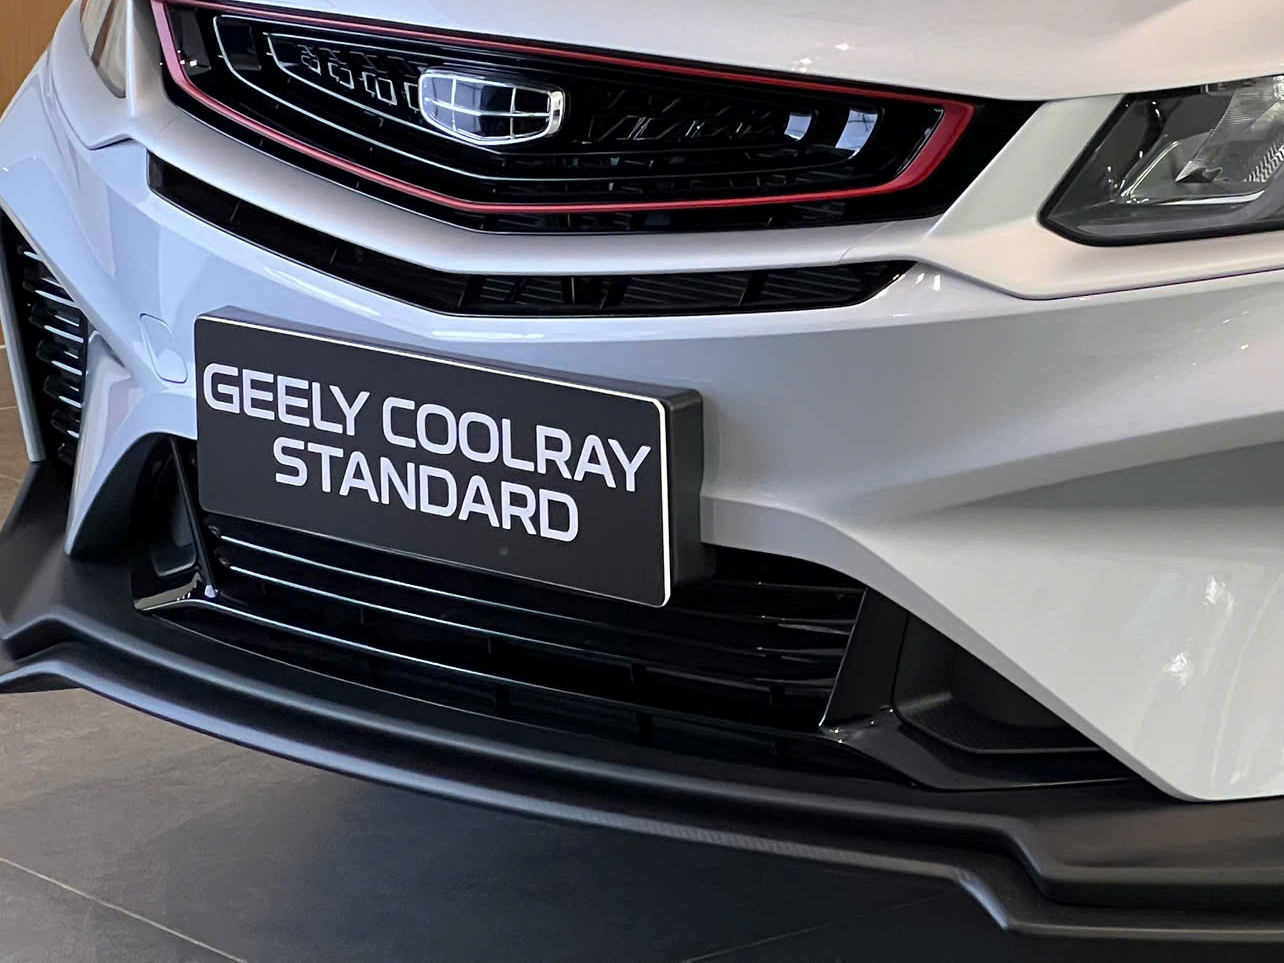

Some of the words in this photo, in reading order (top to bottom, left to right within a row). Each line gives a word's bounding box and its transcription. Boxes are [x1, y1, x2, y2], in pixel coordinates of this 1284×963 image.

[203, 362, 370, 436] GEELY
[382, 396, 652, 492] COOLRAY
[273, 437, 579, 542] STANDARD
